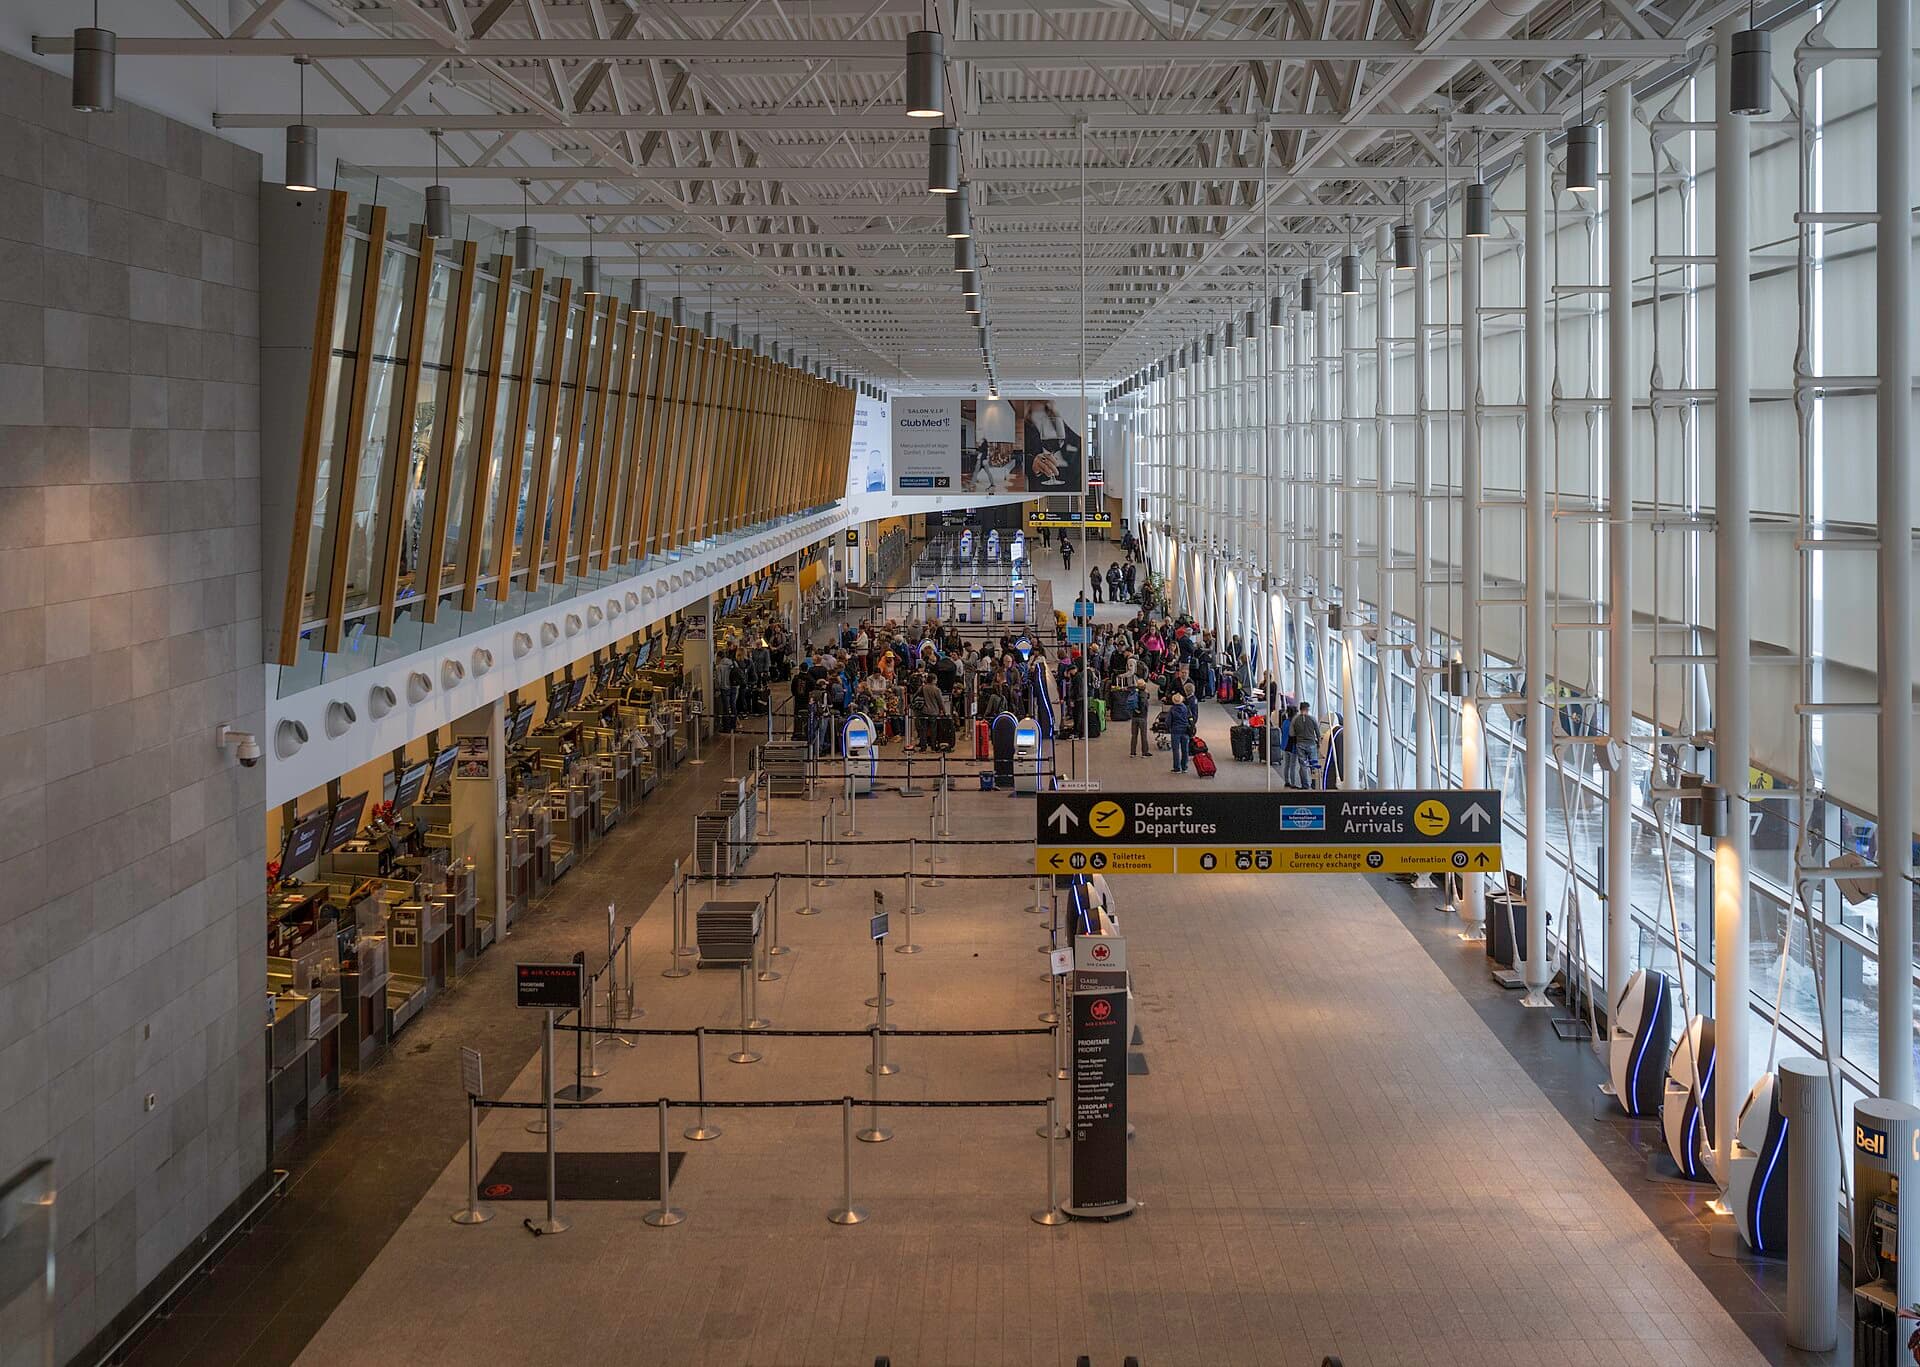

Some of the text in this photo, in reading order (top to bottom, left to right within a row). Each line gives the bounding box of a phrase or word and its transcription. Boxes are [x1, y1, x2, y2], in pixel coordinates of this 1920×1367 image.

[900, 418, 942, 427] Club Med
[1134, 802, 1193, 820] Départs
[1340, 802, 1404, 816] Arrivées
[1134, 820, 1217, 838] Departures
[1344, 819, 1404, 833] Arrivals
[1334, 852, 1361, 862] change
[1400, 856, 1447, 864] Information
[1112, 861, 1152, 869] Restrooms
[1289, 861, 1361, 869] Currency exchange
[1856, 1125, 1884, 1155] Bell
